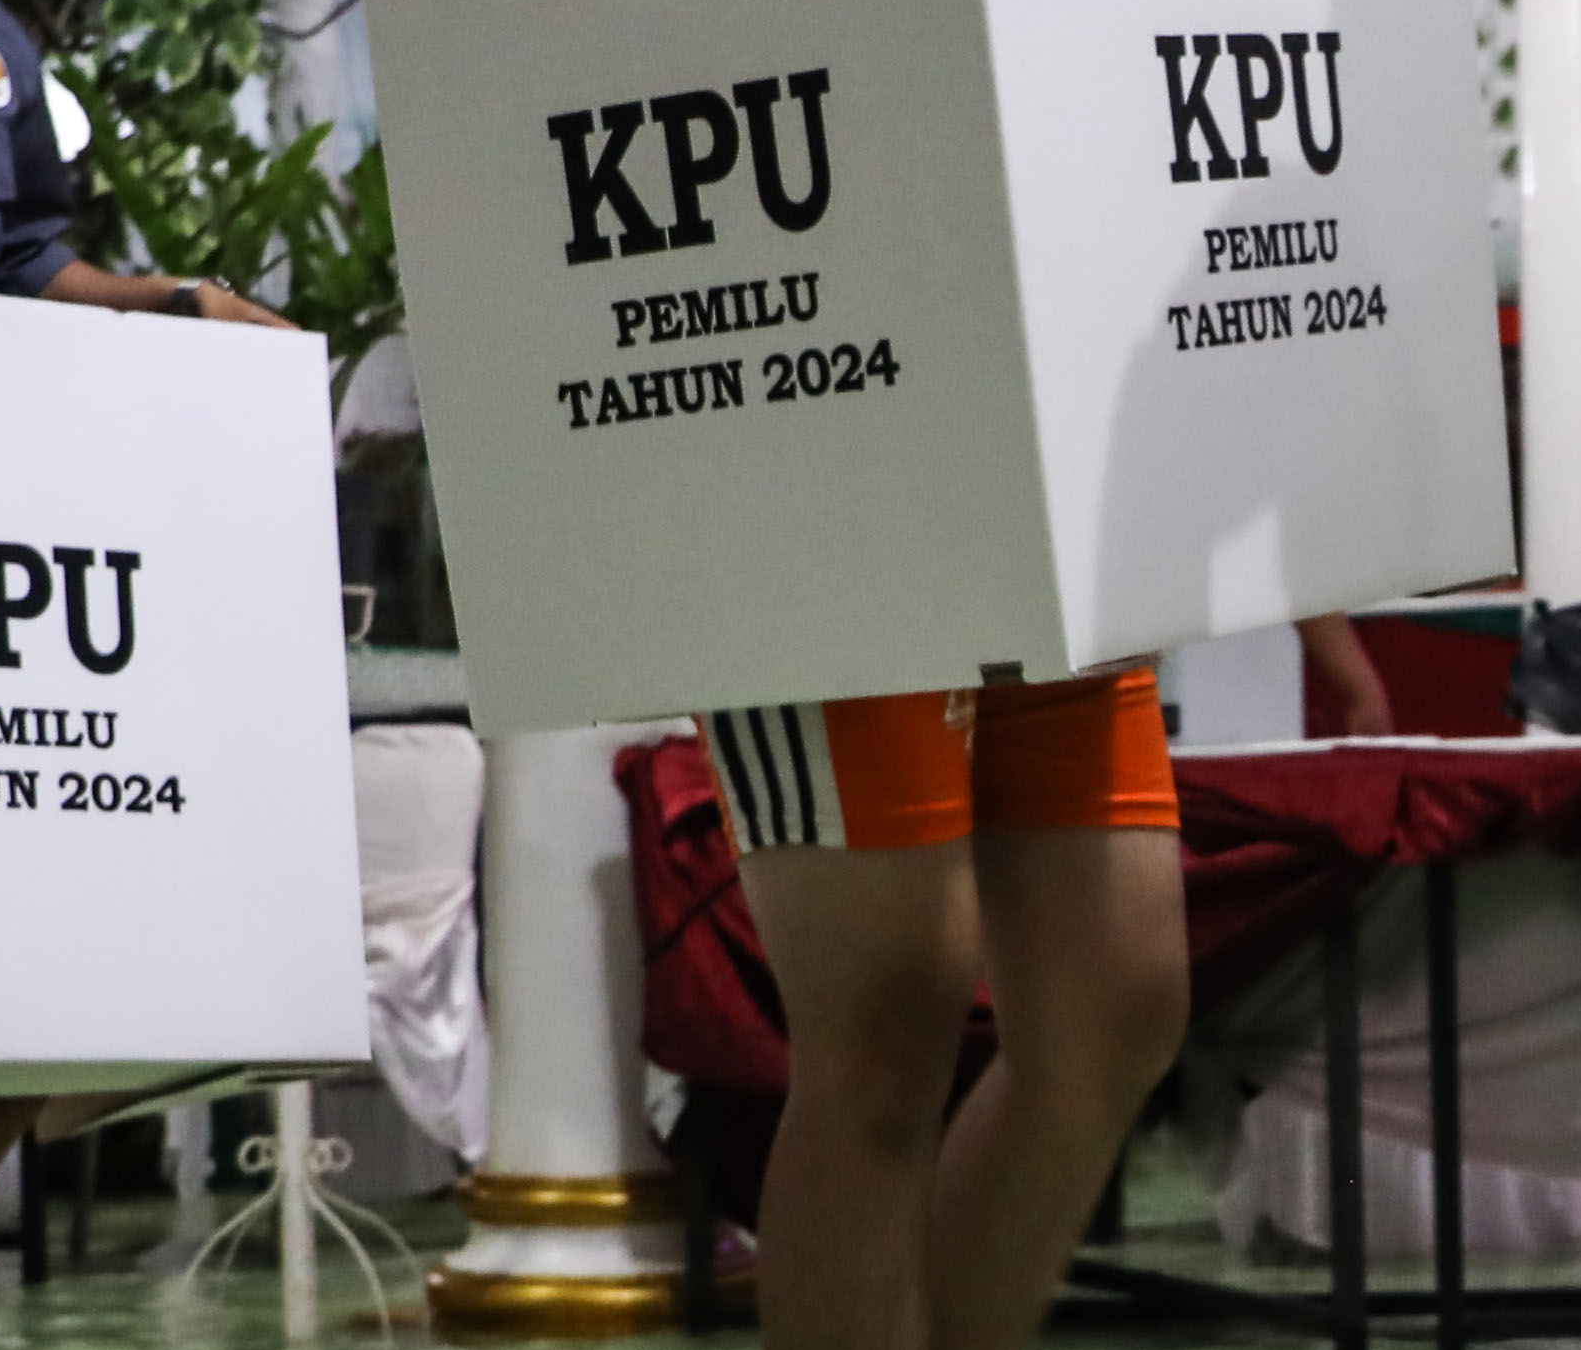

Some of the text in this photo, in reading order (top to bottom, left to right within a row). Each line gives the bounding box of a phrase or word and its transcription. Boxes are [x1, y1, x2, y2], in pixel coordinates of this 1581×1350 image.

[1154, 31, 1343, 184] KPU
[546, 67, 831, 266] KPU
[1204, 218, 1338, 274] PEMILU
[611, 271, 819, 349] PEMILU
[1167, 285, 1387, 351] TAHUN 2024
[557, 338, 901, 430] TAHUN 2024
[58, 771, 186, 814] 2024
